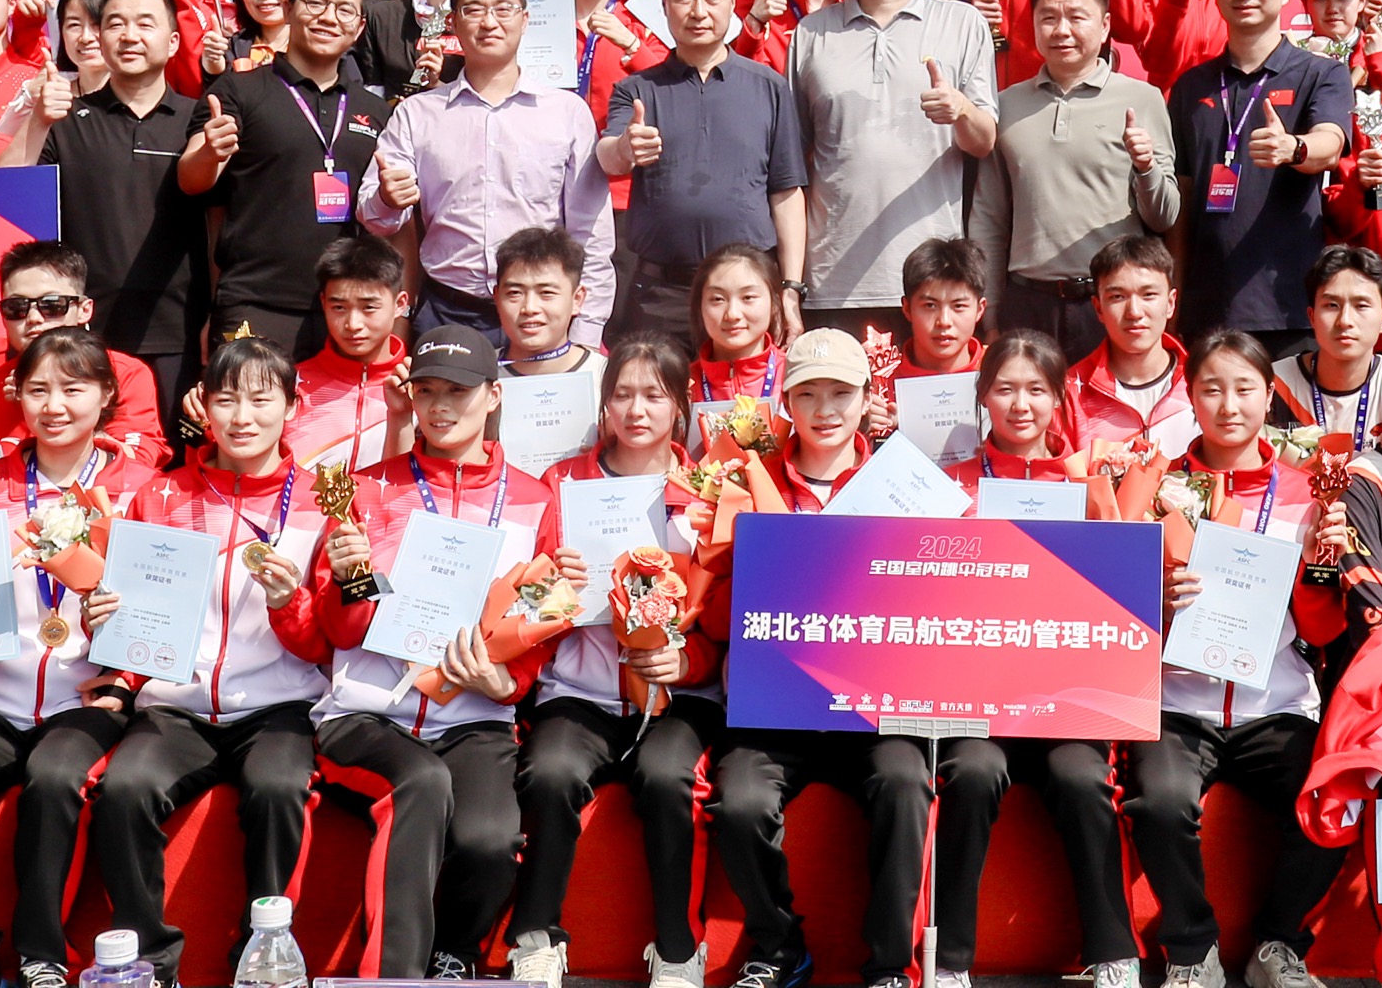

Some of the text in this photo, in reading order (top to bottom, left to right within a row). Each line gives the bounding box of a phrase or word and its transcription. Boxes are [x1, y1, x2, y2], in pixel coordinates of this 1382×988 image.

[535, 418, 561, 427] 获奖证书
[934, 418, 959, 427] 获奖证书
[601, 525, 629, 535] 获奖证书
[917, 535, 982, 560] 2024
[155, 551, 170, 560] ASFC
[1237, 556, 1251, 565] ASFC
[430, 565, 457, 577] 获奖证书
[869, 559, 1030, 579] 全国室内跳伞冠军赛
[144, 573, 172, 585] 获奖证书
[1224, 577, 1252, 590] 获奖证书
[742, 610, 1150, 652] 湖北省体育局航空运动管理中心
